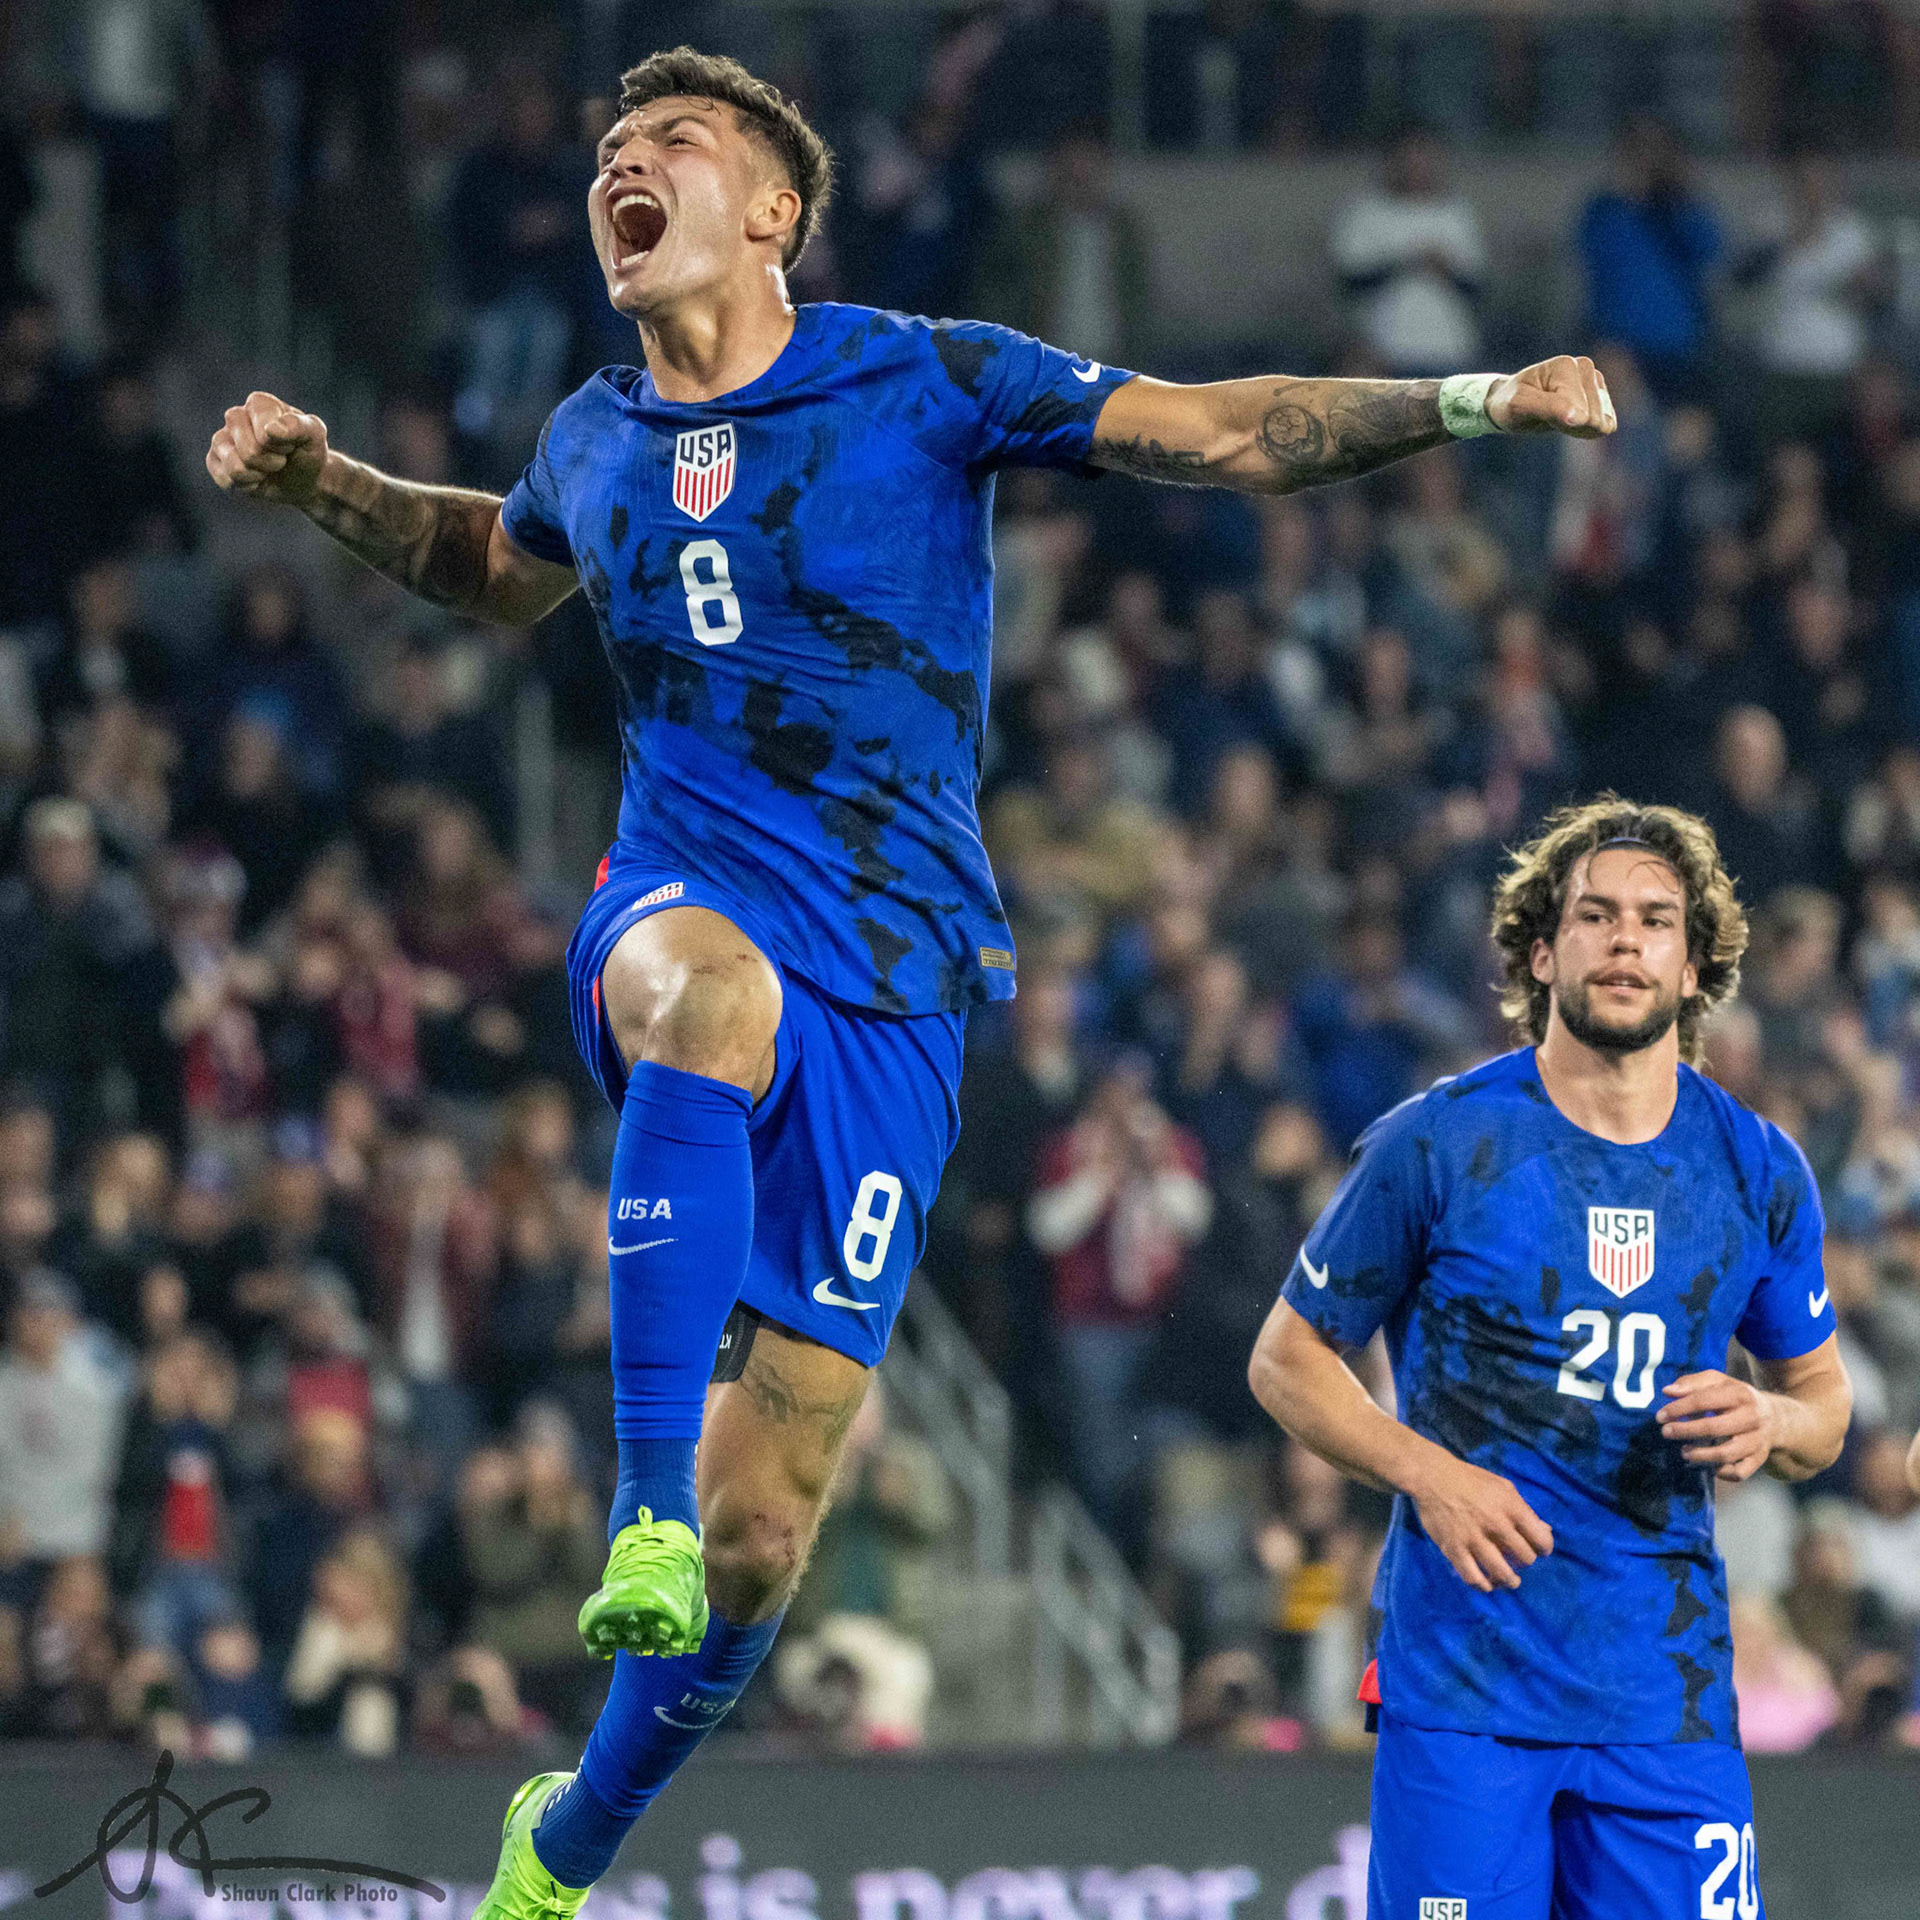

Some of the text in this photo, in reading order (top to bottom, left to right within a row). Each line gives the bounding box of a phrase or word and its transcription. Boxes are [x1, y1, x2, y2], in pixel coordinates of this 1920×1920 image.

[679, 428, 732, 468] USA
[679, 538, 744, 646] 8
[617, 1198, 672, 1220] USA
[843, 1170, 903, 1282] 8
[1594, 1212, 1649, 1245] USA
[1556, 1308, 1667, 1408] 20
[1694, 1822, 1759, 1920] 20
[1424, 1901, 1463, 1920] USA
